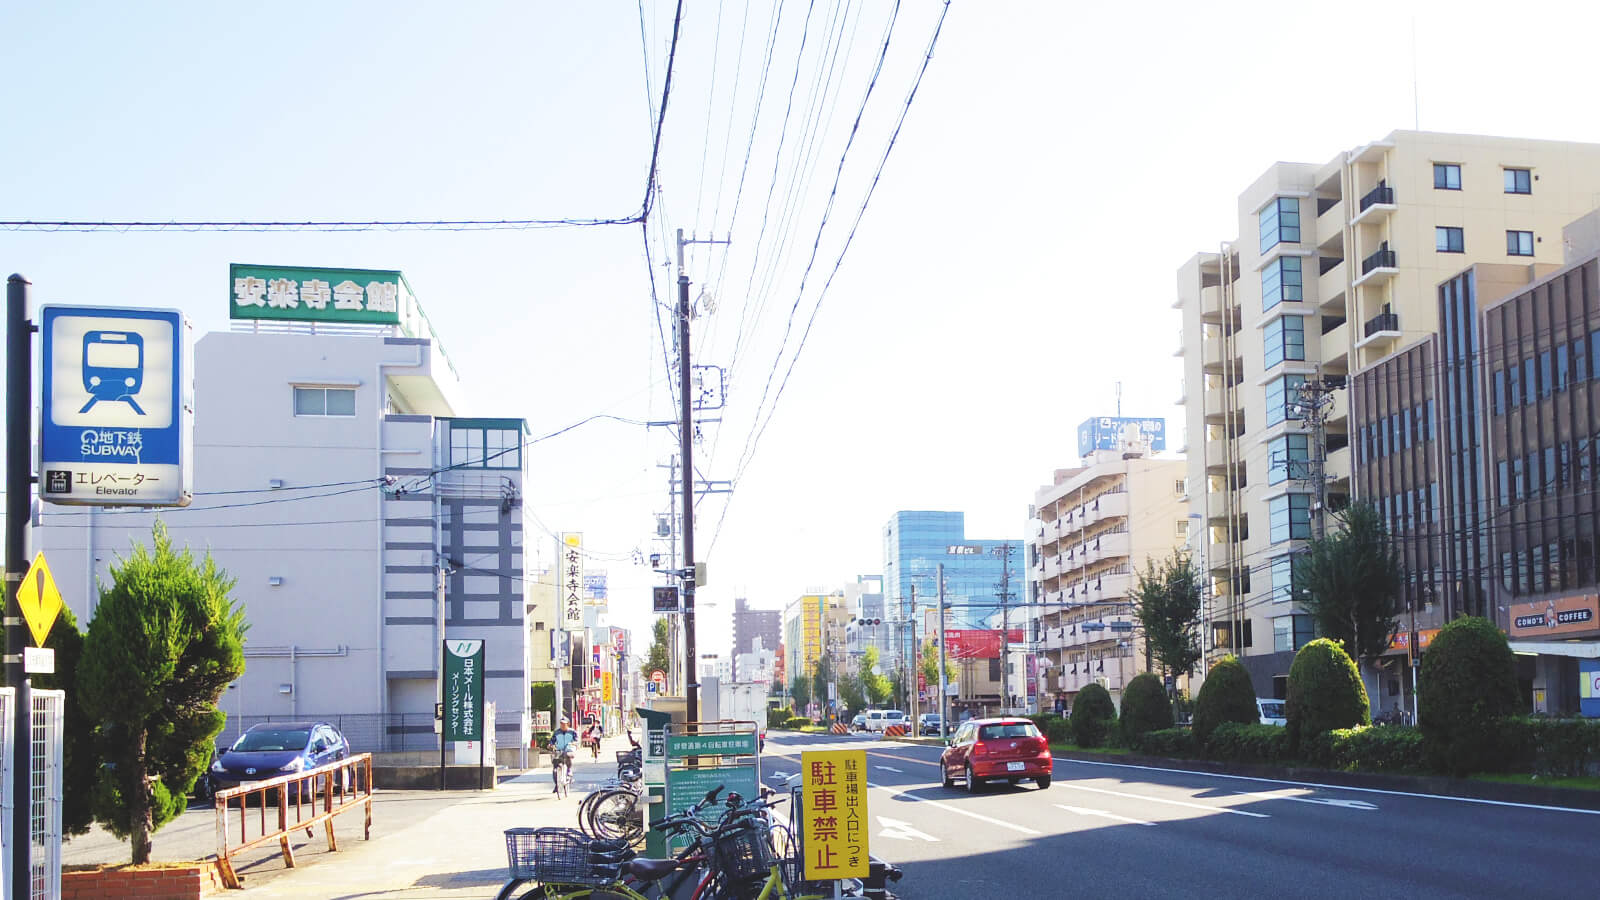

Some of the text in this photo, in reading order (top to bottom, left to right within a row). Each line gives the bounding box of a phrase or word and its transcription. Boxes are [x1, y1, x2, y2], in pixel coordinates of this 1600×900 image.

[234, 275, 398, 313] 安楽寺会館
[80, 444, 141, 457] SUBWAY
[99, 431, 142, 445] 地下鉄
[75, 472, 160, 486] エレベーター
[96, 486, 138, 496] Elevator
[565, 550, 581, 621] 安楽寺会館
[1558, 611, 1588, 621] COFFEE
[451, 671, 460, 736] メーリングセンター
[463, 658, 474, 736] 日本メール株式会社
[811, 761, 839, 871] 駐車禁止
[844, 759, 861, 868] 駐車場出入口につき
